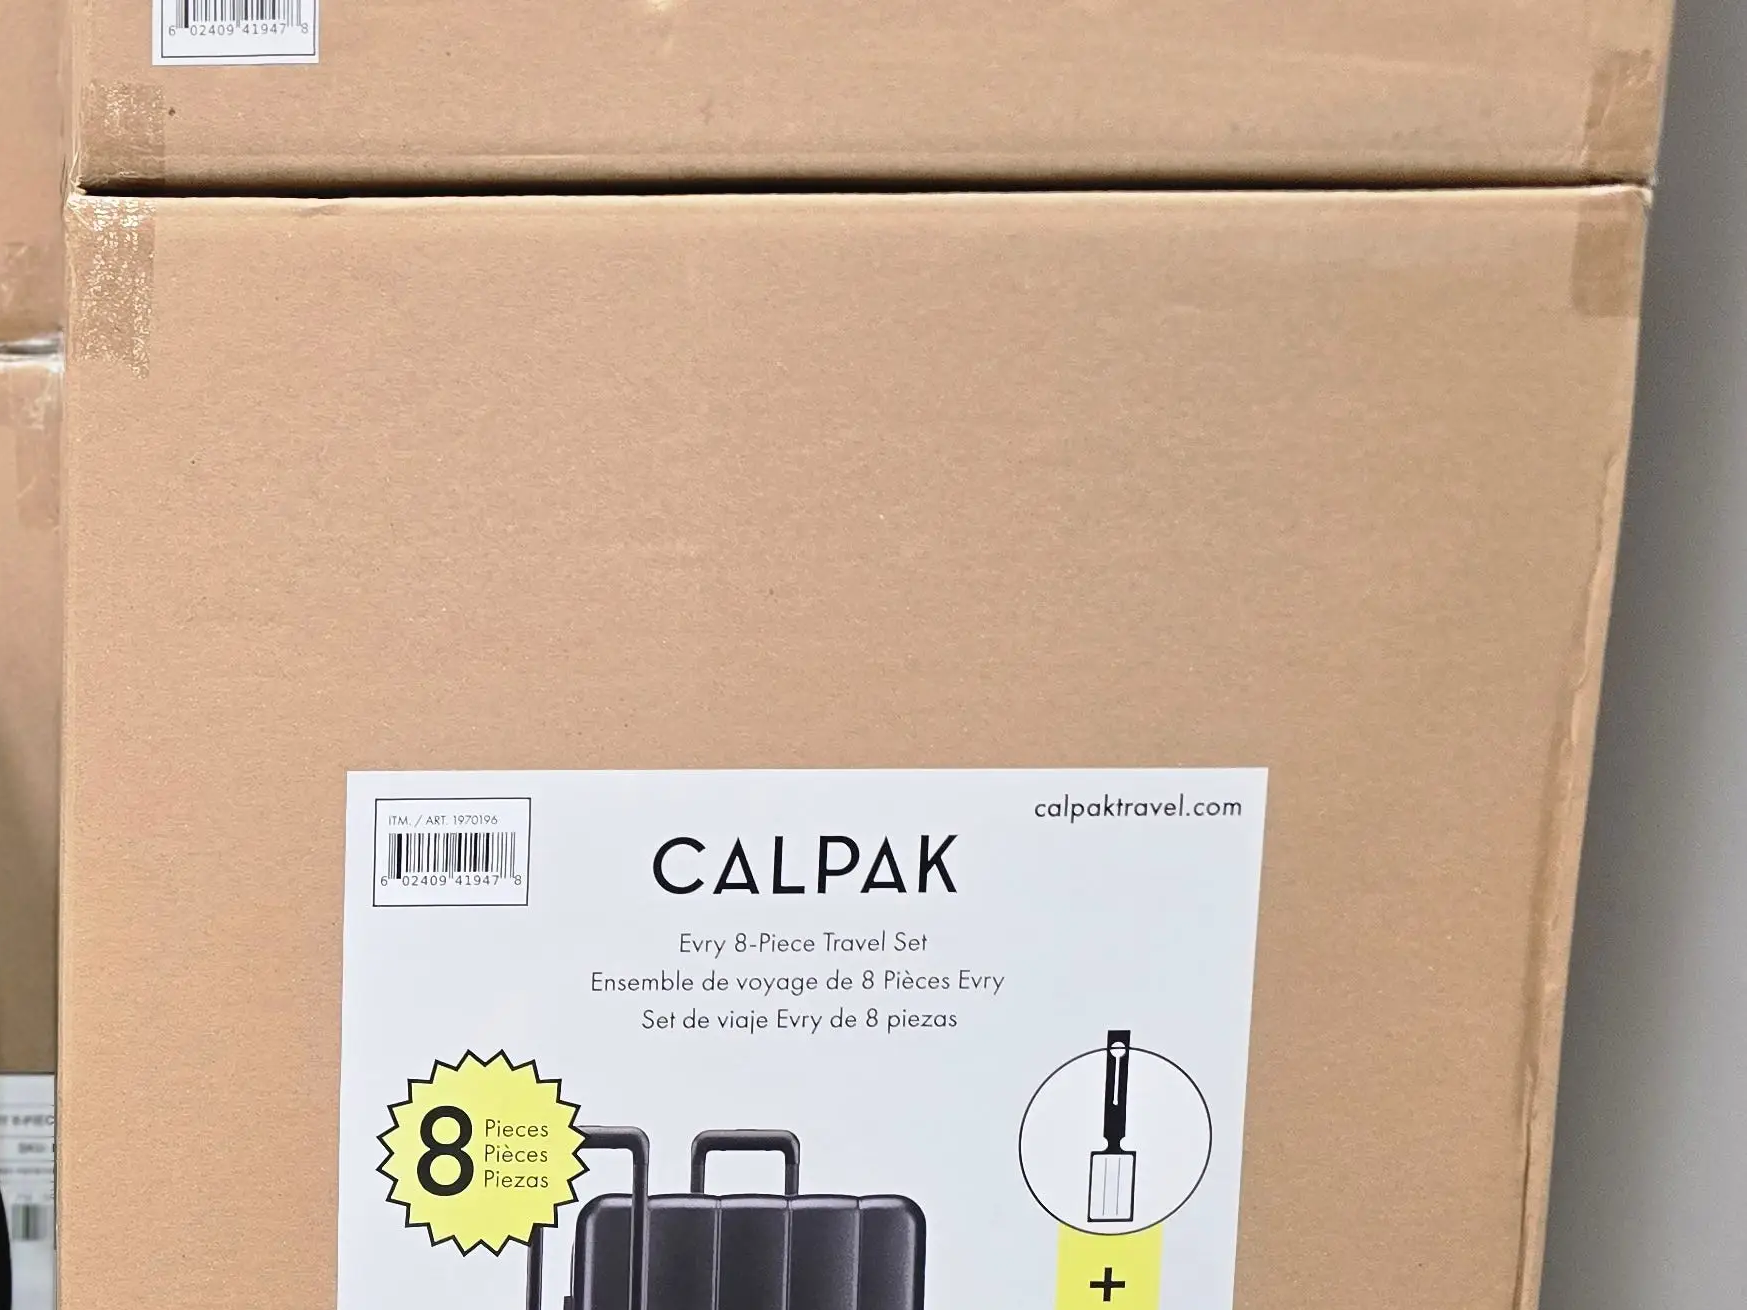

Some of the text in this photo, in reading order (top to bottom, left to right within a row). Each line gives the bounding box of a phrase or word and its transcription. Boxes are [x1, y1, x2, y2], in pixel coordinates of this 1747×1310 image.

[169, 22, 308, 36] 6 02409 41947 8
[414, 814, 424, 828] /
[454, 815, 498, 825] 1970196
[1035, 793, 1241, 823] calpaktravel.com
[653, 835, 958, 894] CALPAK
[381, 875, 521, 886] 6 02409 41947 8
[680, 932, 927, 958] Evry 8-Piece Travel Set
[592, 969, 1004, 996] Ensemble de voyage de 8 Pièces Evry
[642, 1007, 957, 1034] Set de viaje Evry de 8 piezas
[486, 1119, 548, 1137] Pieces
[417, 1106, 547, 1196] 8 Pièces
[485, 1170, 548, 1188] Piezas
